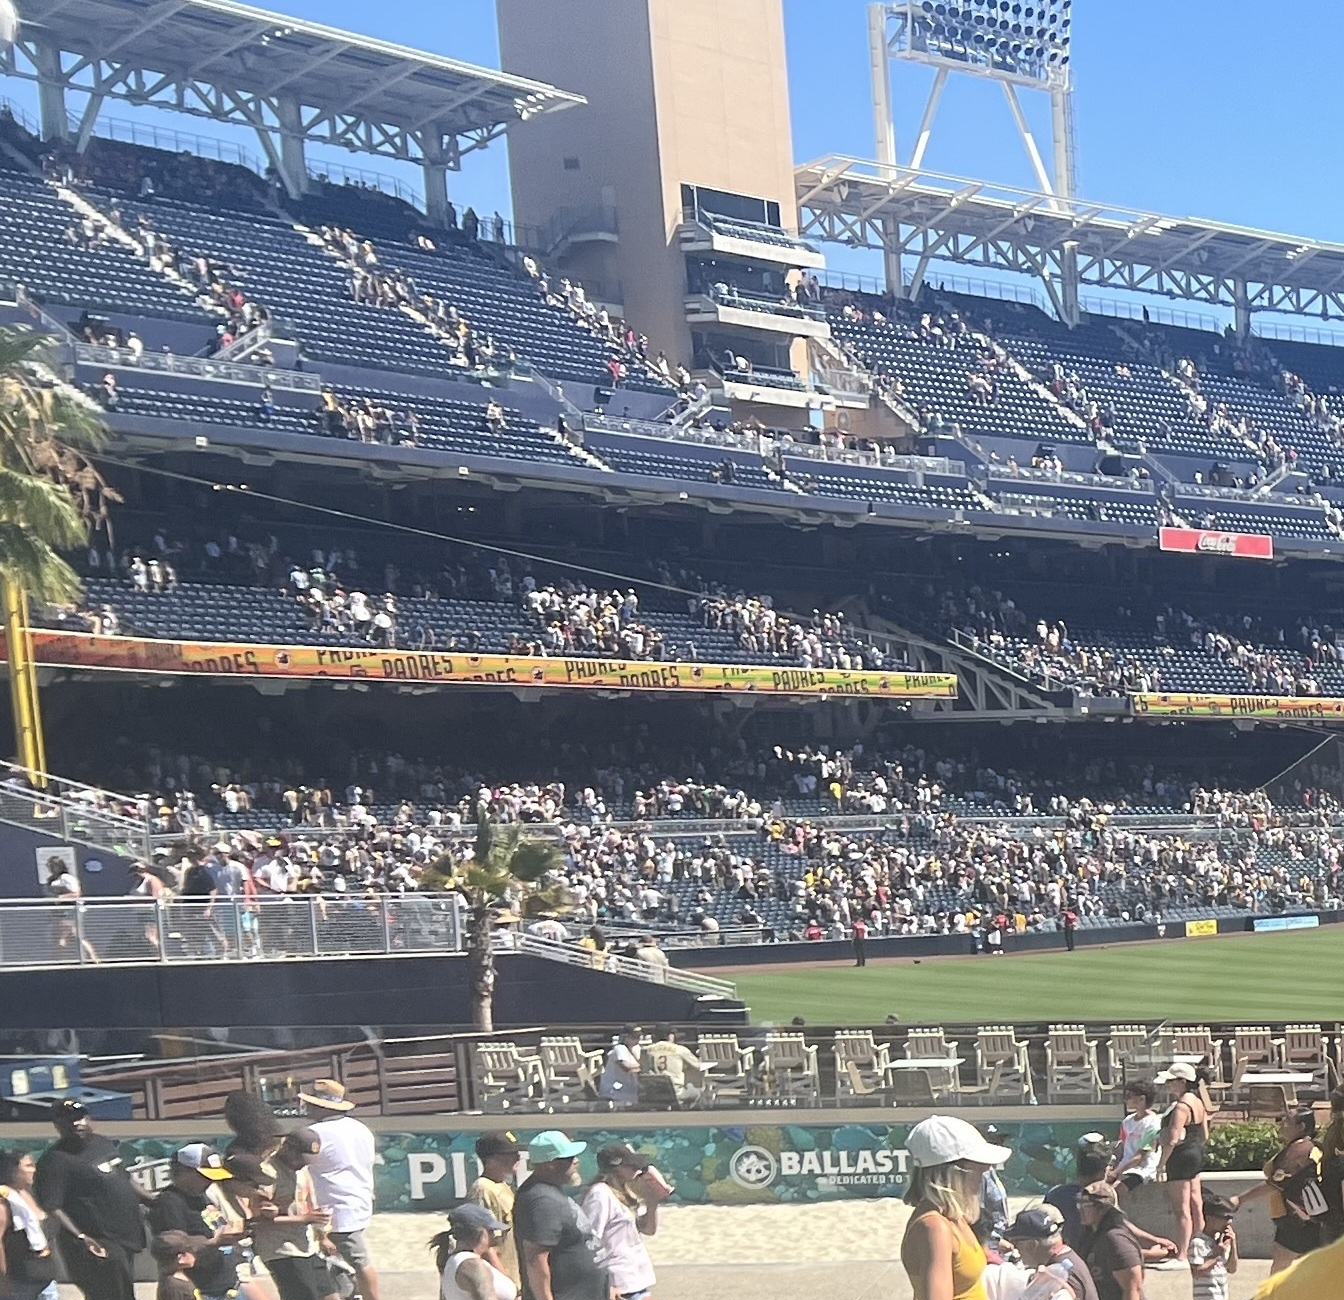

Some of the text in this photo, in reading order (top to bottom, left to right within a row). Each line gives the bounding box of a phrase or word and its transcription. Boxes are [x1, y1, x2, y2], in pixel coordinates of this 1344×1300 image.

[780, 1149, 911, 1176] BALLAST
[829, 1174, 903, 1185] DEDICATED TO
